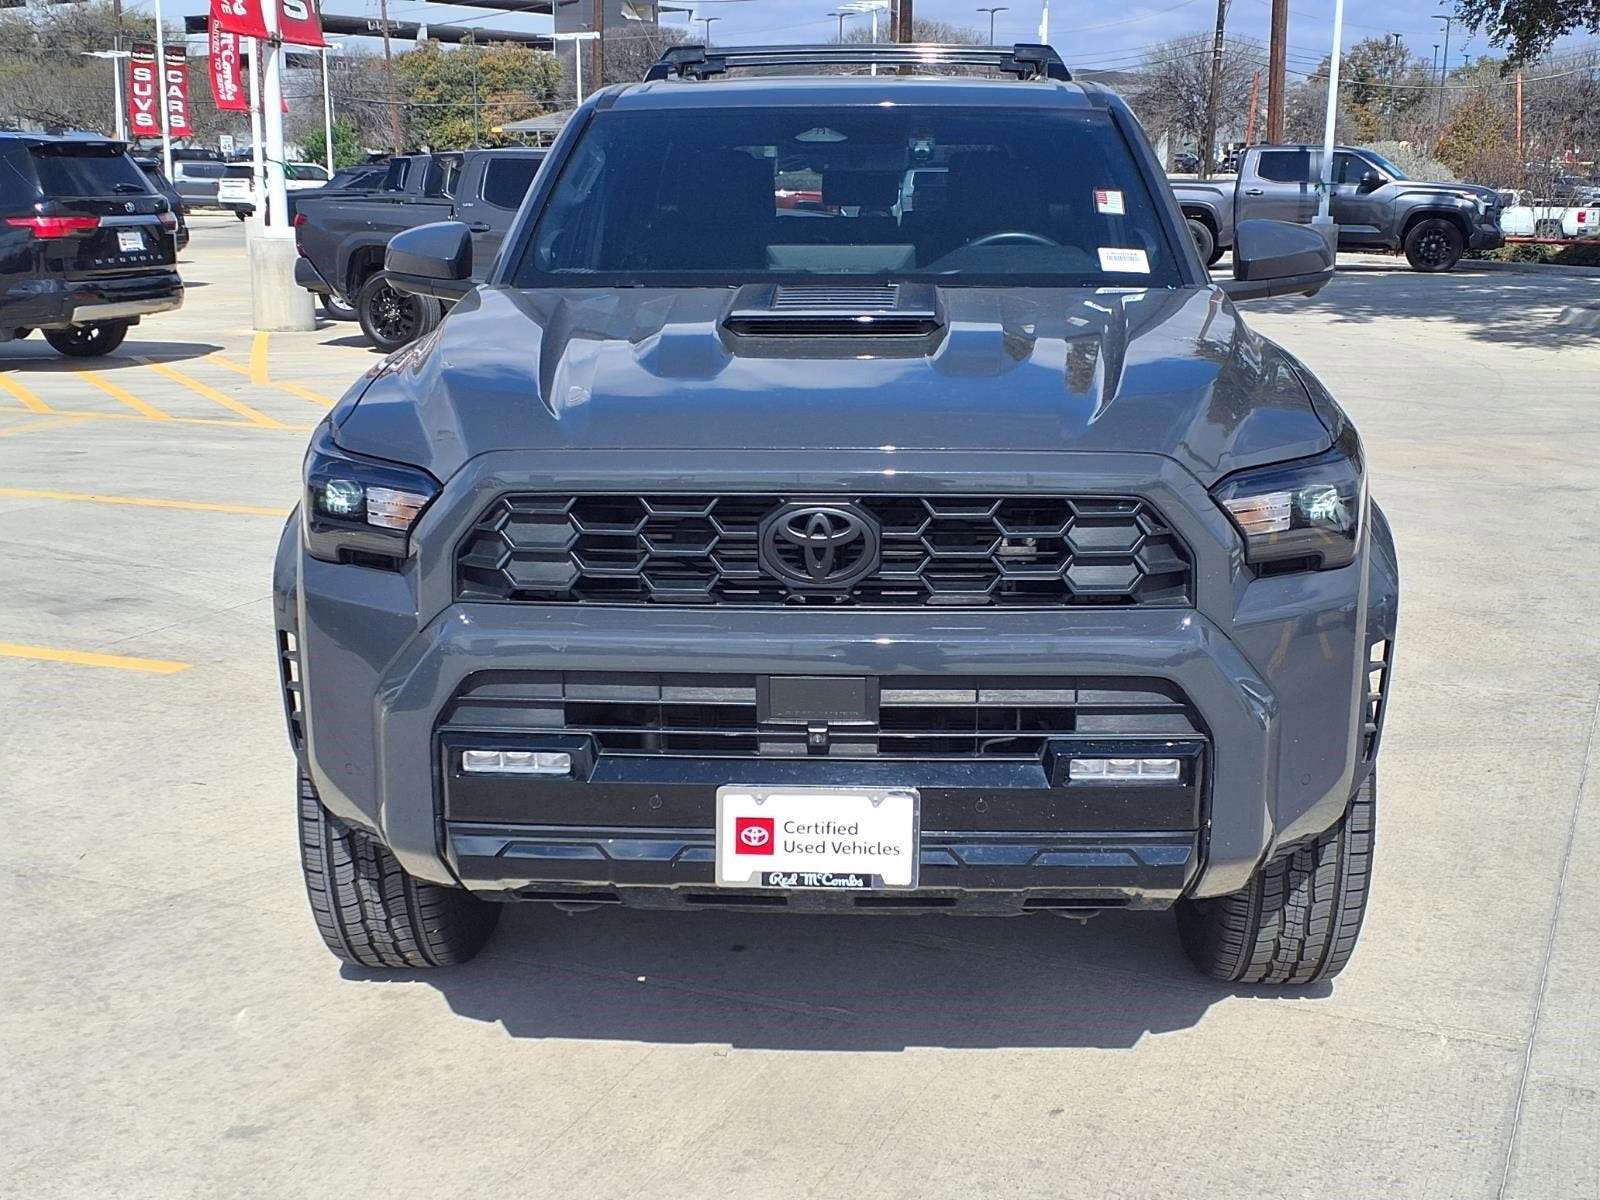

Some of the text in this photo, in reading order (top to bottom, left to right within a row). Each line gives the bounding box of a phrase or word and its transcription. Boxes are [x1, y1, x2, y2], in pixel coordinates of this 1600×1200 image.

[214, 57, 222, 71] TO
[215, 73, 227, 101] SERVE
[132, 67, 154, 126] SUVS
[166, 70, 186, 127] CARS
[783, 820, 859, 836] Certified
[783, 840, 900, 856] Used Vehicles
[768, 872, 864, 888] Red McCombs
